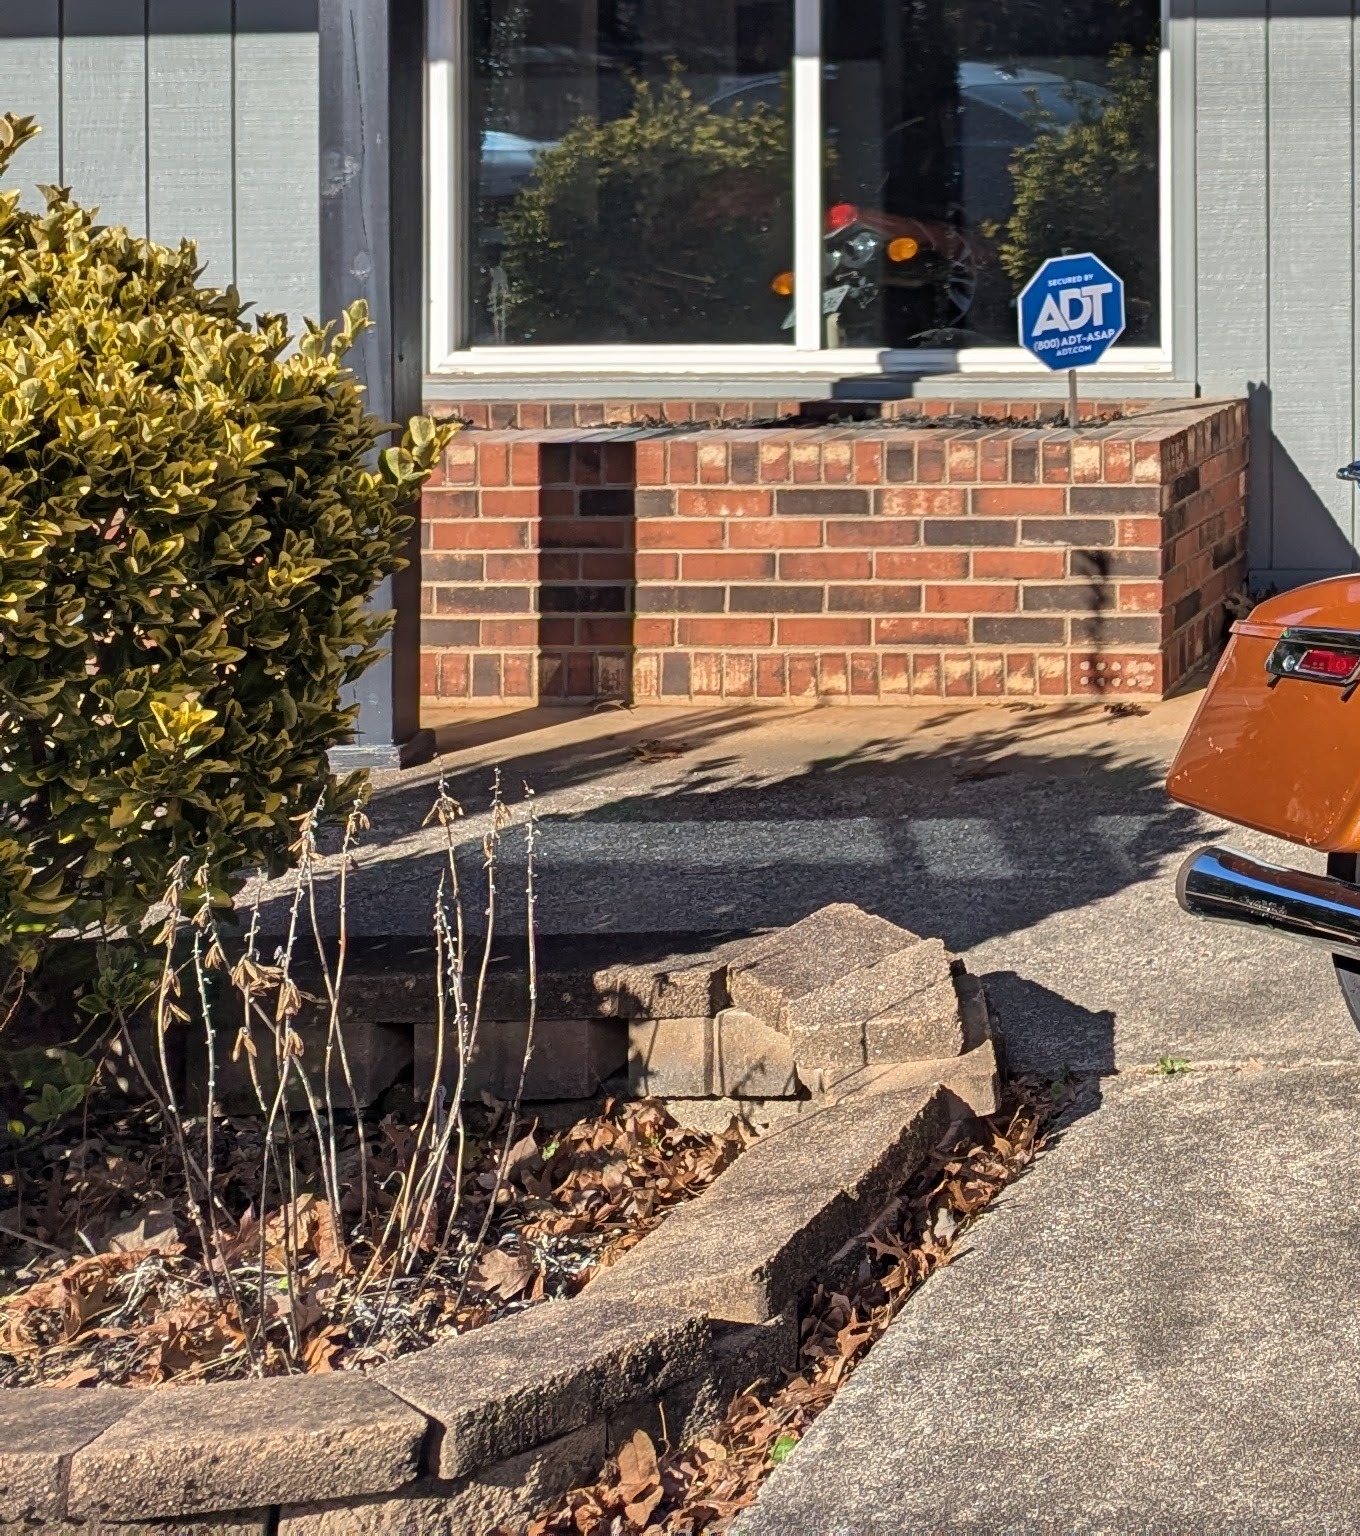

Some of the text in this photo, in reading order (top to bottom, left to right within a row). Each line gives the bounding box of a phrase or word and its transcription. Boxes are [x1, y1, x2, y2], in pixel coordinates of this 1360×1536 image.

[1047, 273, 1095, 287] SECURED BY
[1031, 282, 1114, 338] ADT
[1033, 327, 1116, 353] (800) ADT-ASAP
[1055, 344, 1093, 357] ADT.COM
